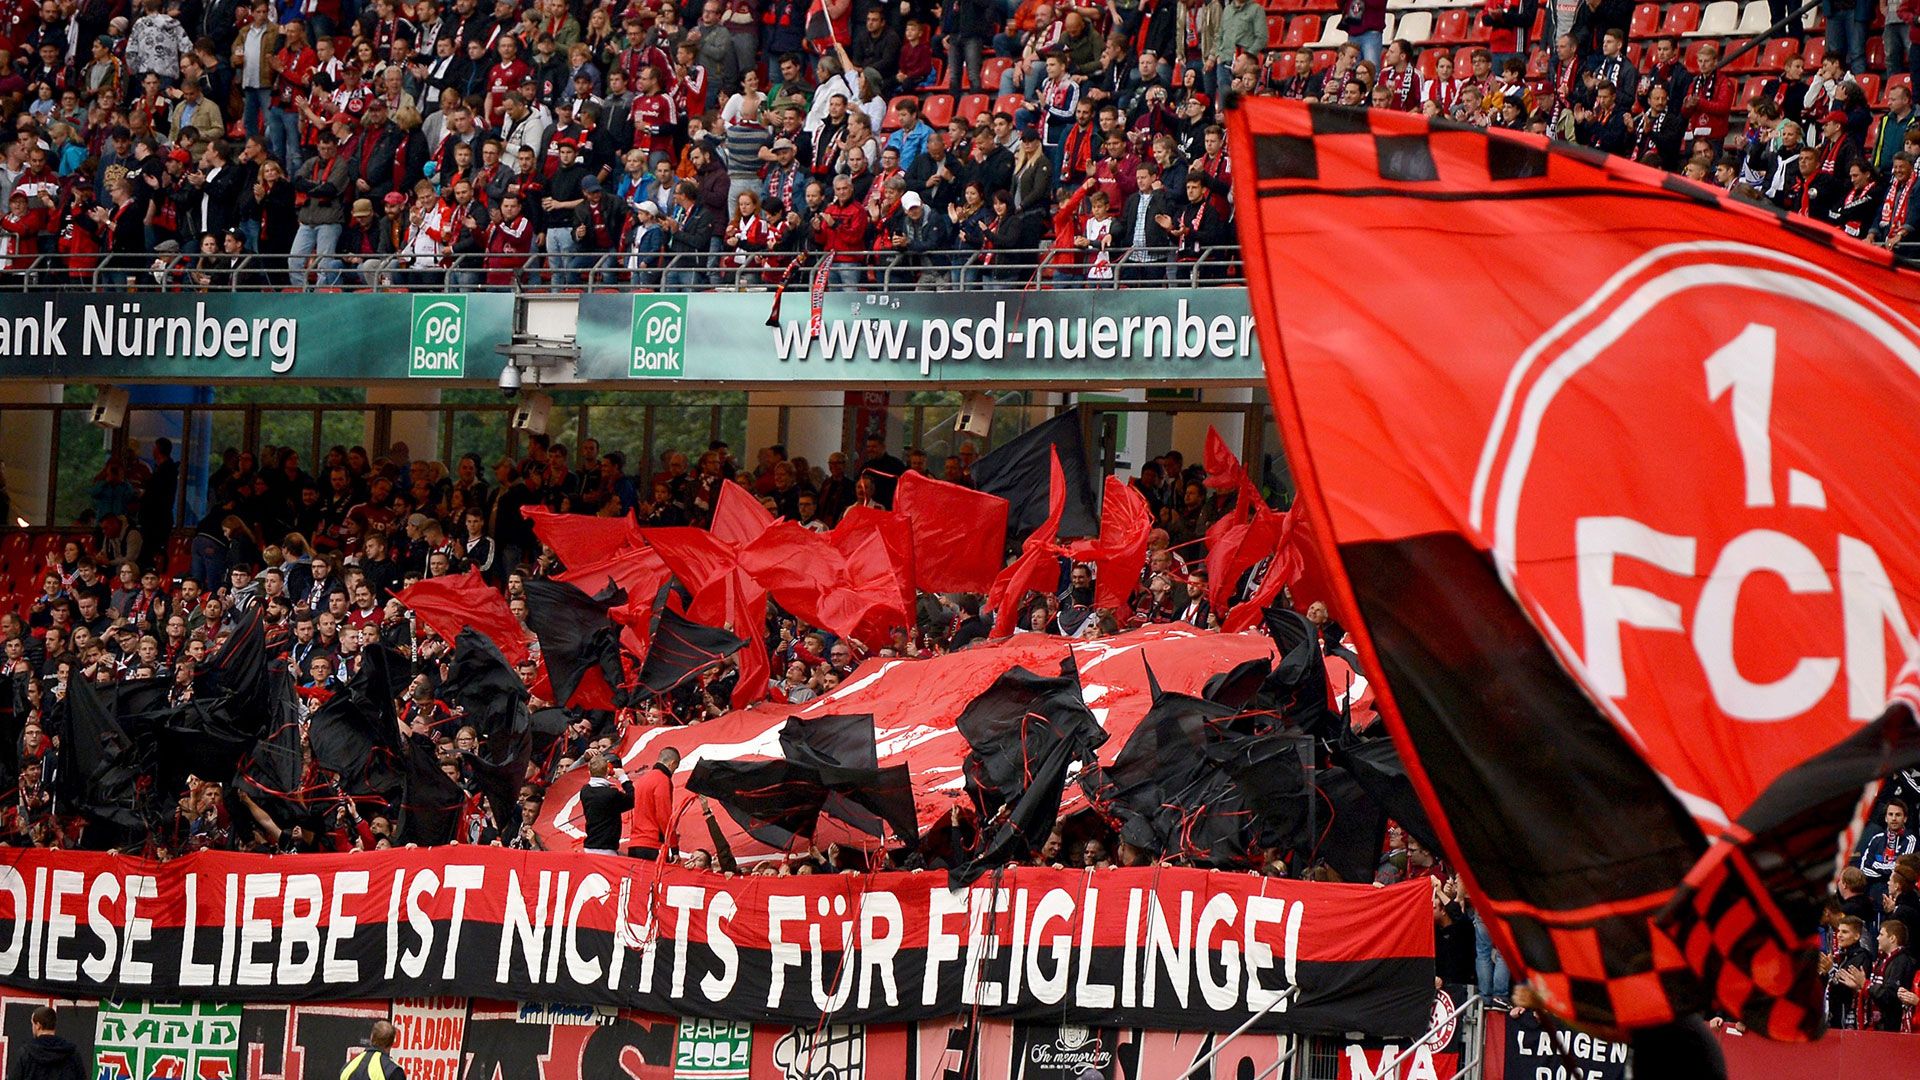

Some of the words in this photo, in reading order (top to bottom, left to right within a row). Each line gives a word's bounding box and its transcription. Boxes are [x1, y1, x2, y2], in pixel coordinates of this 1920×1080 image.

[81, 301, 297, 374] Nürnberg
[425, 316, 461, 343] psd
[646, 316, 681, 343] psd
[774, 299, 1260, 375] www.psd-nuernber
[414, 346, 459, 369] Bank
[634, 346, 679, 369] Bank
[1704, 322, 1826, 510] 1.
[0, 865, 156, 984] DIESE
[179, 870, 371, 986] LIEBE
[384, 865, 485, 981] IST
[495, 869, 739, 1002] NICHTS
[766, 891, 904, 1013] FÜR
[922, 887, 1304, 1012] FEIGLINGE!
[102, 1018, 237, 1044] RAPID
[392, 1014, 463, 1050] STADION
[680, 1016, 751, 1039] RAPID
[678, 1041, 749, 1067] 2004
[1517, 1030, 1628, 1063] LANGEN
[398, 1057, 458, 1080] ERBOT
